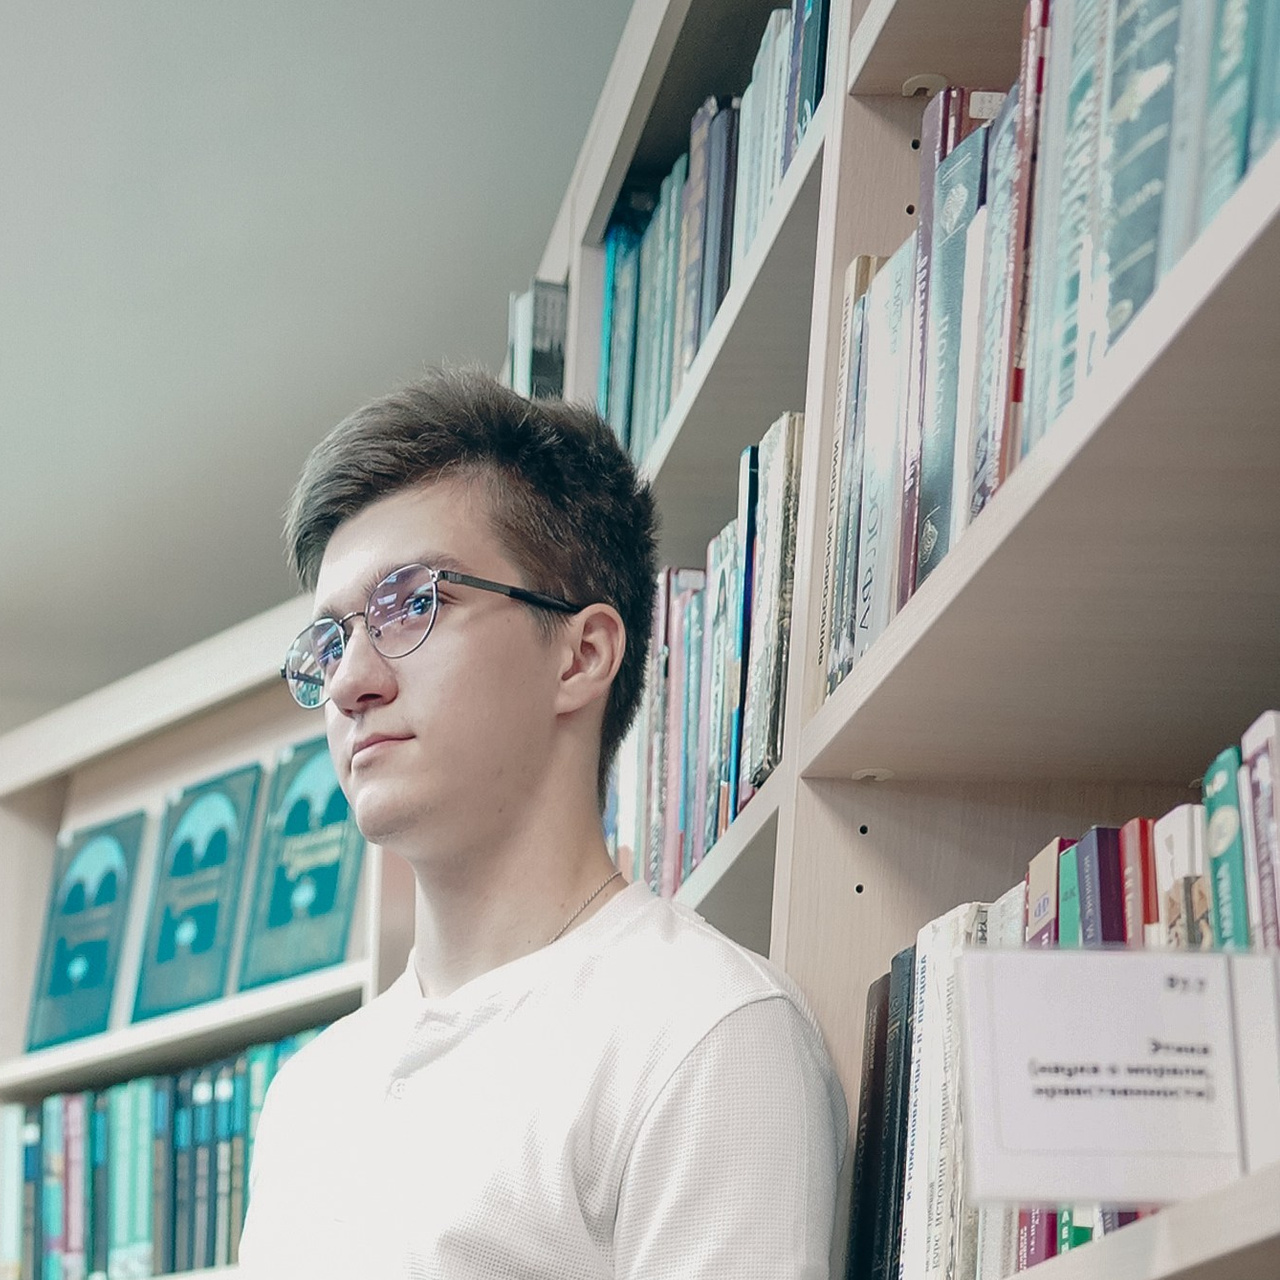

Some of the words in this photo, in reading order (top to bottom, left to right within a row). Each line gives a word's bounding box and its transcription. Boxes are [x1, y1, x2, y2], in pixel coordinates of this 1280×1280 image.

[815, 517, 834, 665] ФИЛОСОФСКИЕ
[826, 439, 841, 513] ТЕОРИИ
[915, 952, 928, 1023] ПЕРЦОВА
[933, 1155, 947, 1226] ИСТОРИИ
